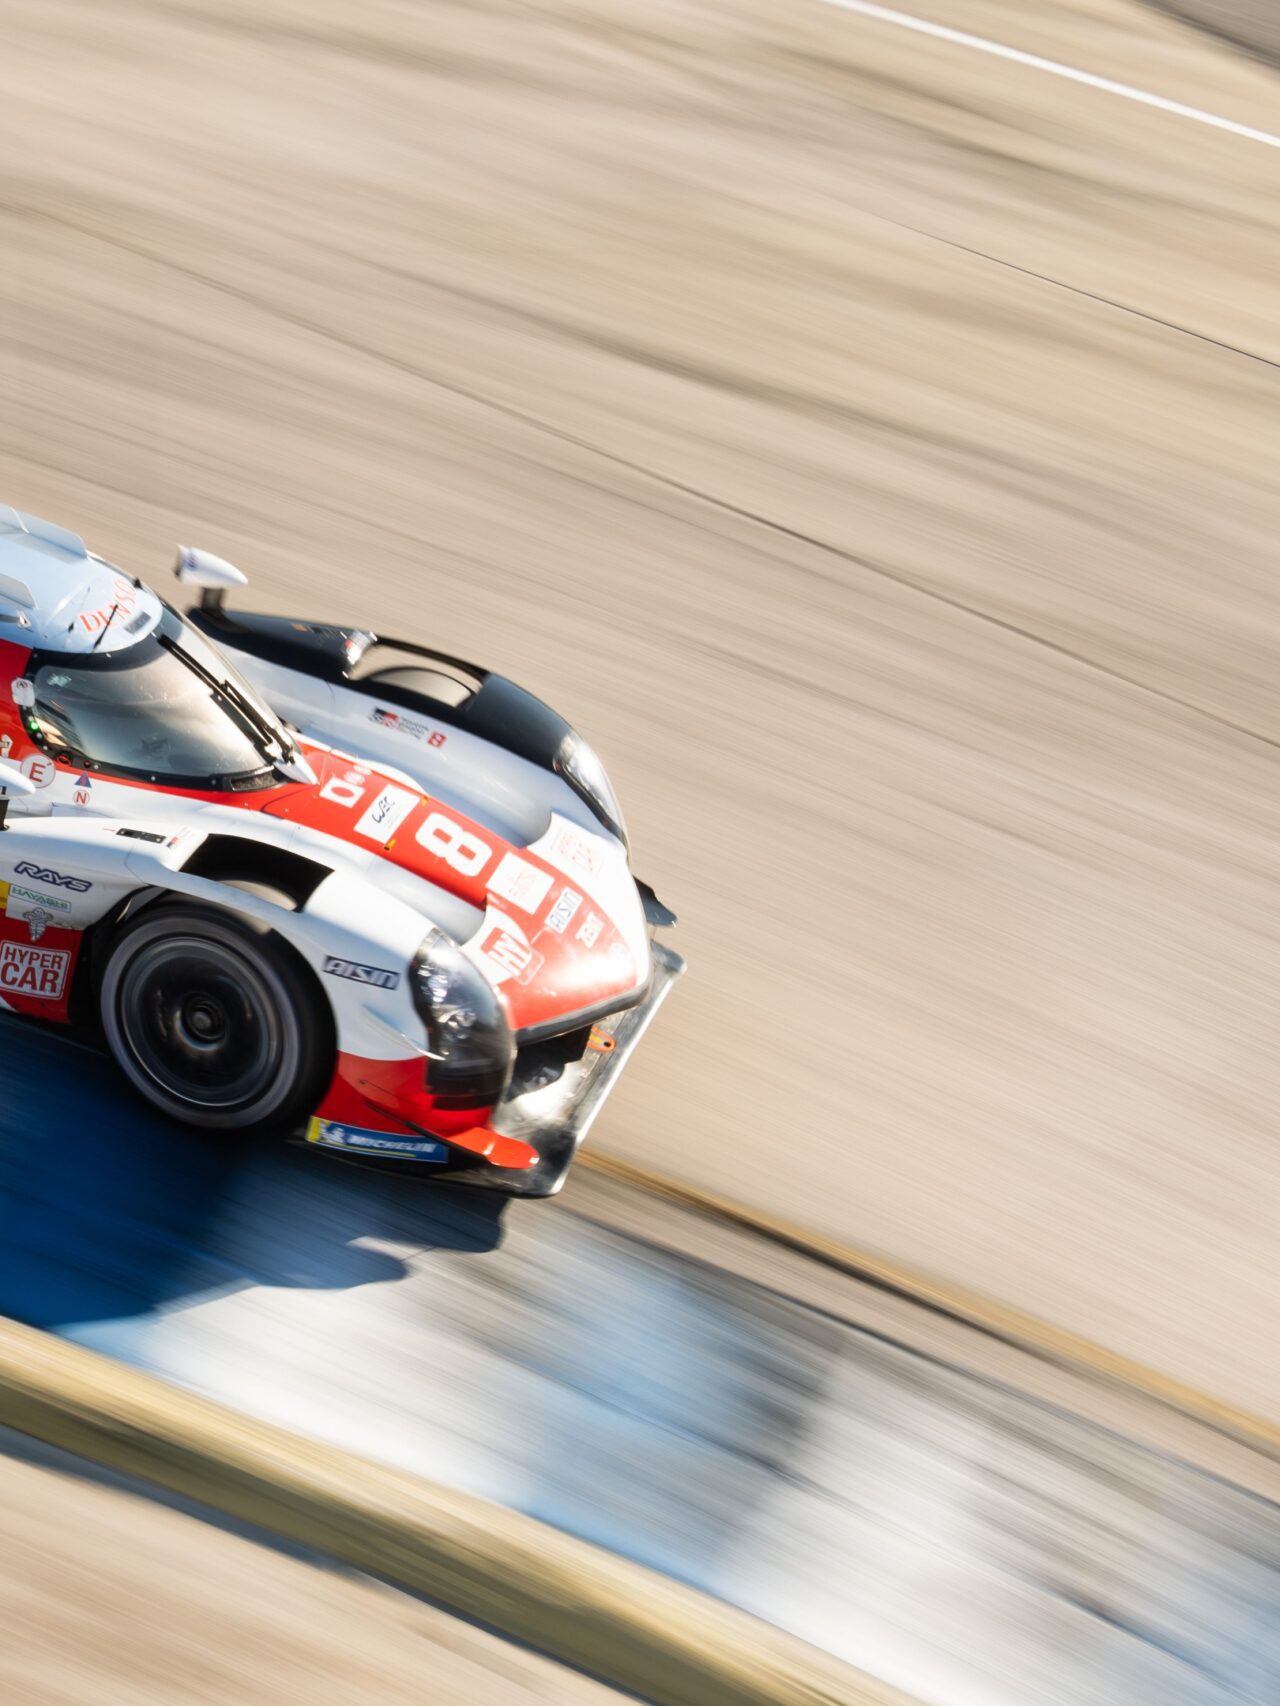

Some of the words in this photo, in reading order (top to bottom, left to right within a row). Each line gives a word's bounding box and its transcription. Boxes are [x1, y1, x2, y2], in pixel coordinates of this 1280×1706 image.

[80, 579, 136, 633] DENSO
[29, 762, 46, 783] E
[75, 791, 87, 804] N
[415, 812, 492, 877] 8
[14, 861, 92, 892] RAYS
[4, 946, 63, 970] HYPER
[0, 960, 60, 993] CAR
[325, 959, 398, 988] AISIN
[347, 1134, 437, 1153] MICHELIN
